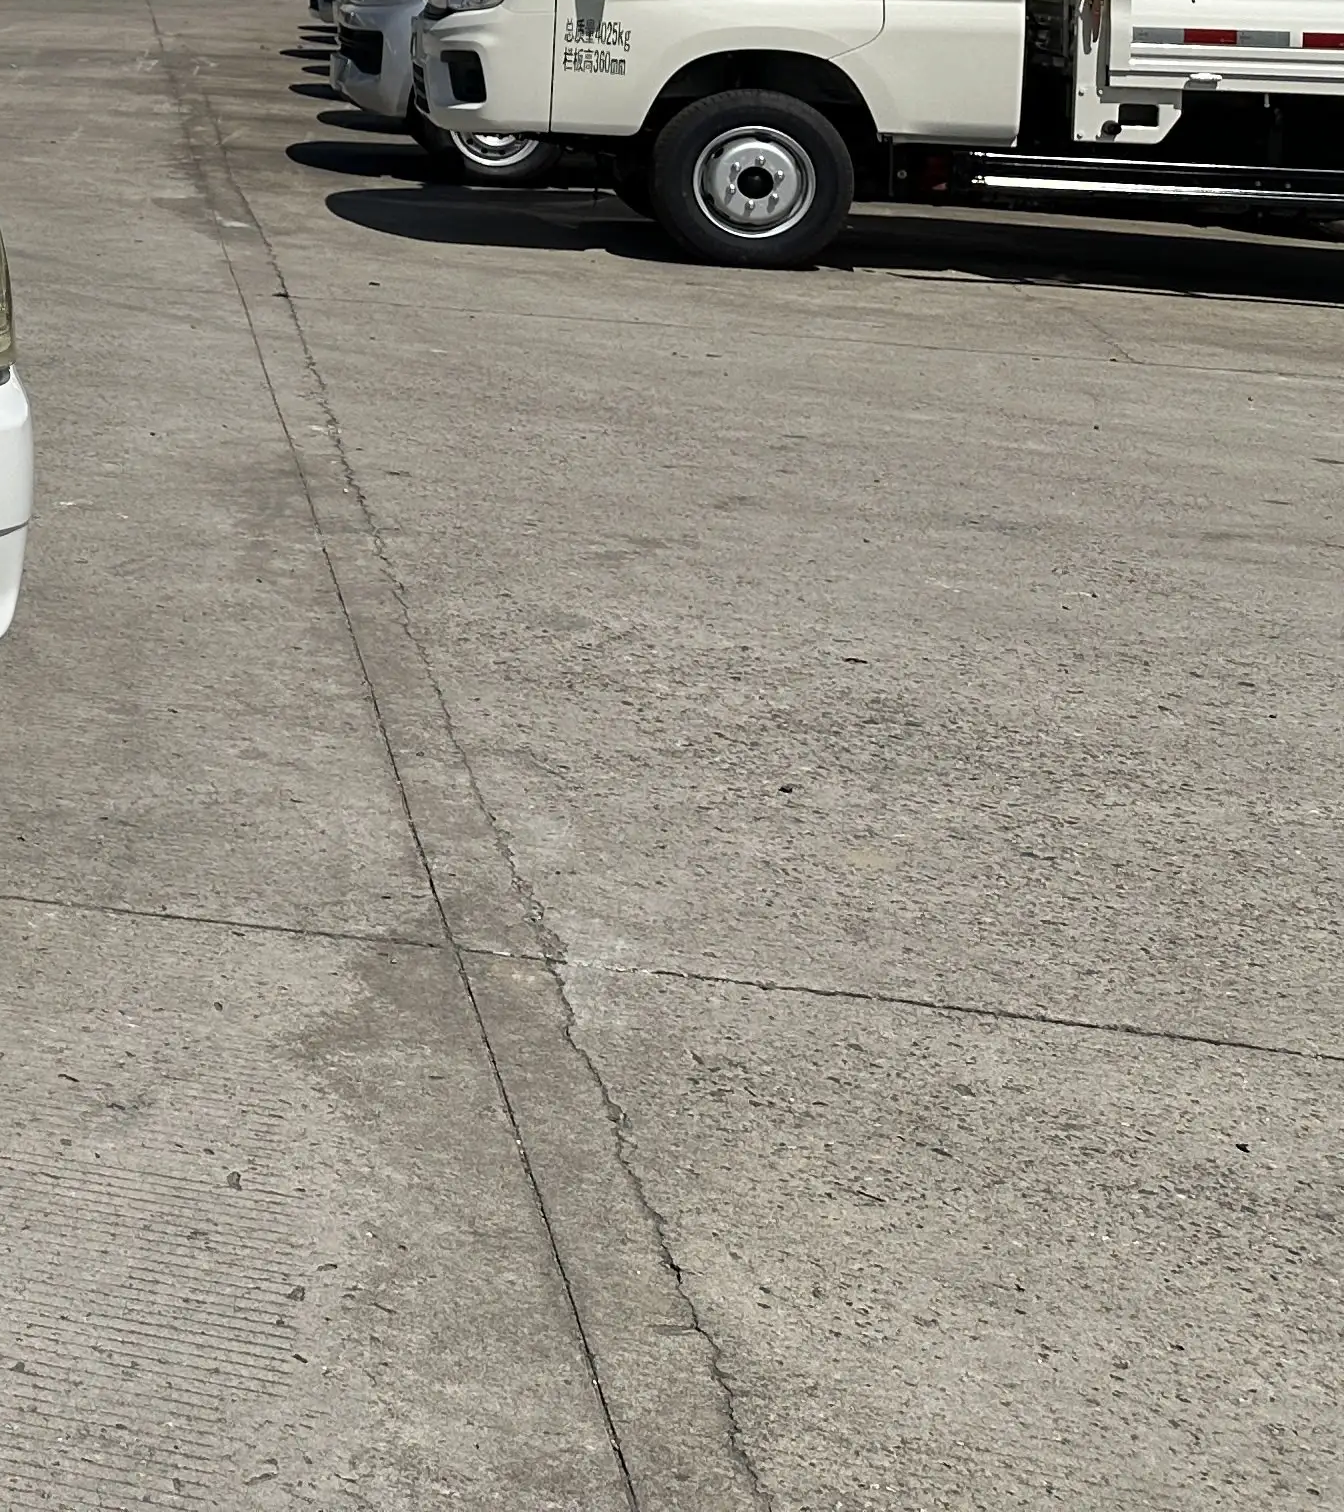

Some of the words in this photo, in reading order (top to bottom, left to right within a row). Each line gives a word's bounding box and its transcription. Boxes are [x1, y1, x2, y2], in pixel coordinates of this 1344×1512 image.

[564, 18, 632, 52] 总质量4025kg
[562, 46, 626, 76] 栏板高360mm
